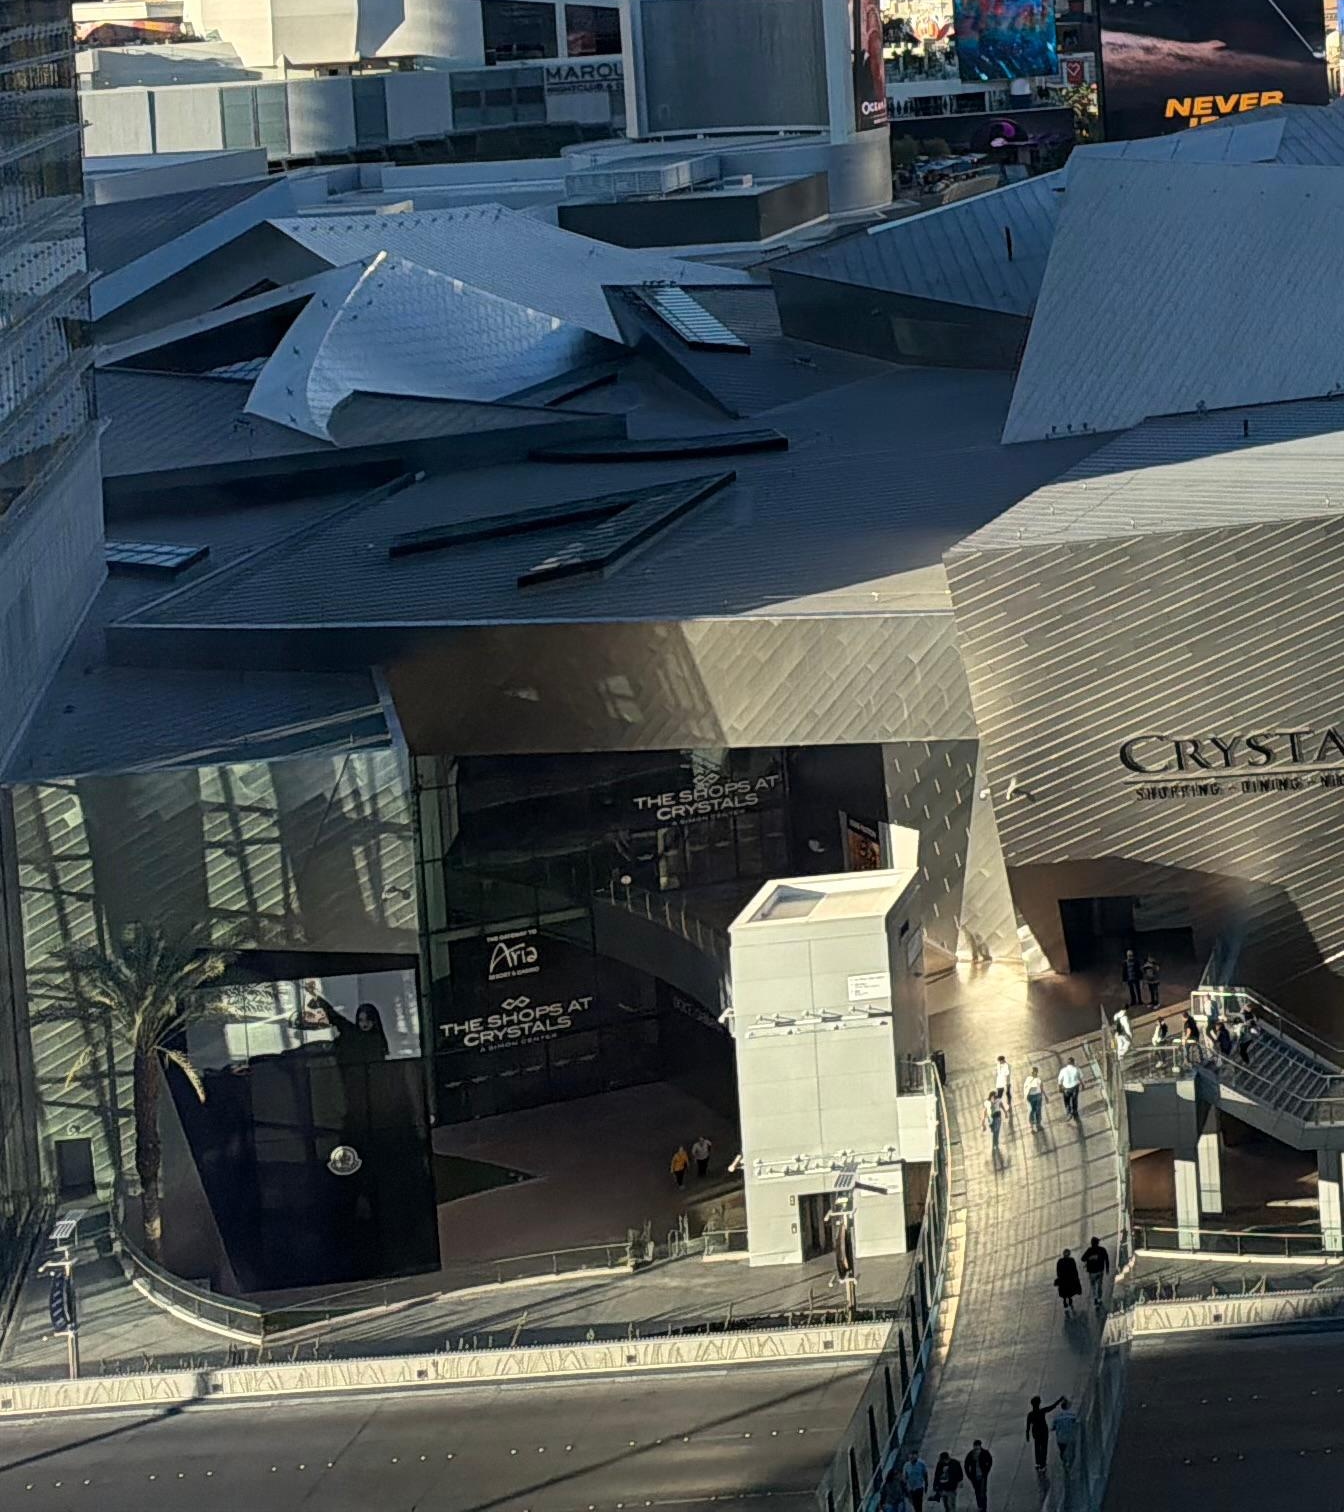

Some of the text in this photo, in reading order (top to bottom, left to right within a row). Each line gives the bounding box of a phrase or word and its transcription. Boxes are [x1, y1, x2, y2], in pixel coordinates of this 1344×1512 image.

[1164, 90, 1284, 118] NEVER
[633, 774, 780, 810] THE SHOPS AT
[656, 792, 760, 821] CRYSTALS
[489, 942, 538, 973] Aria
[440, 996, 593, 1037] THE SHOPS AT
[463, 1015, 572, 1047] CRYSTALS
